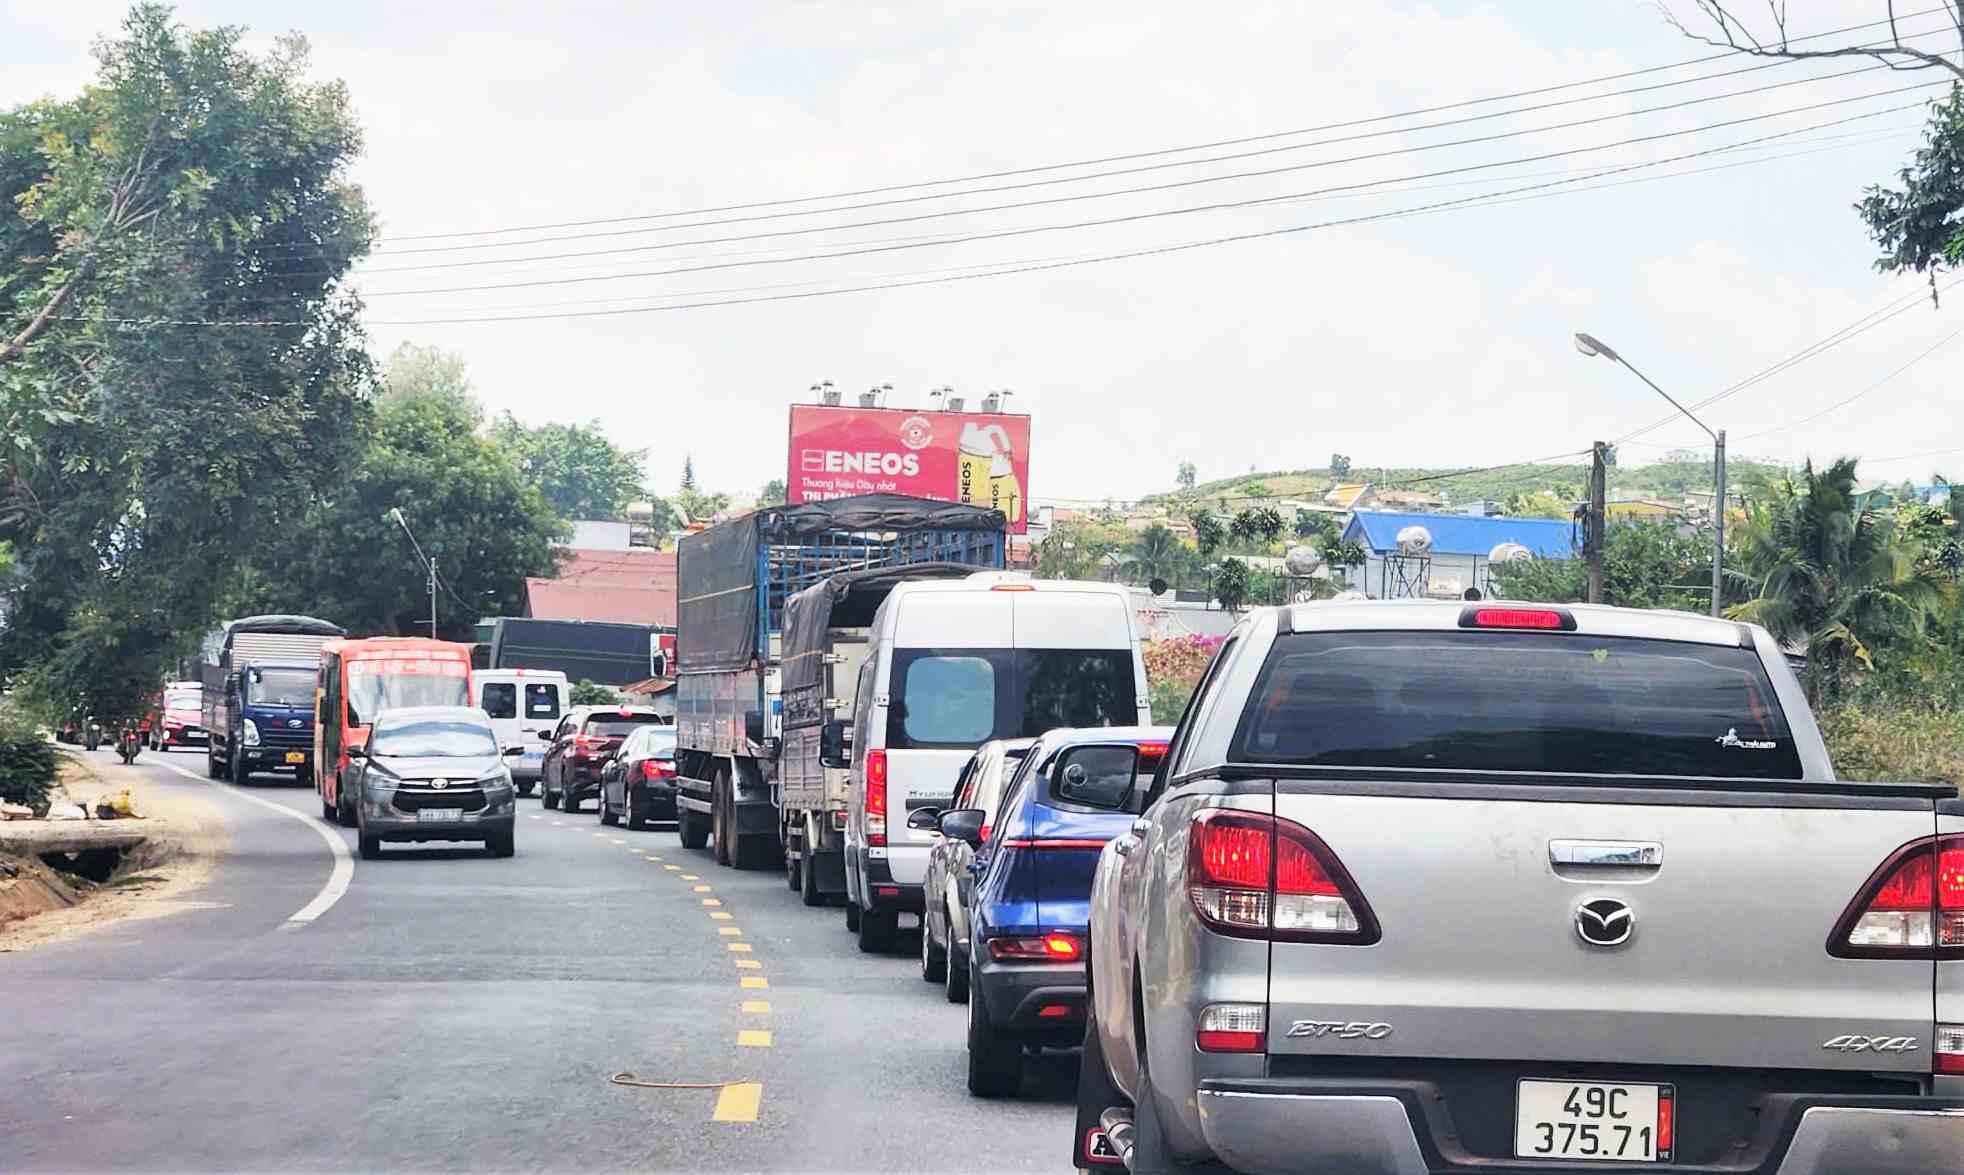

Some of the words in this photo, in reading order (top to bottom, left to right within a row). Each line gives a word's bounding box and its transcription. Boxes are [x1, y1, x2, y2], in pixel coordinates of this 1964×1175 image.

[826, 451, 919, 476] ENEOS
[962, 462, 972, 503] ENEOS
[1286, 1020, 1392, 1039] BT-50
[1563, 1086, 1628, 1119] 49C
[1534, 1122, 1651, 1157] 375.71
